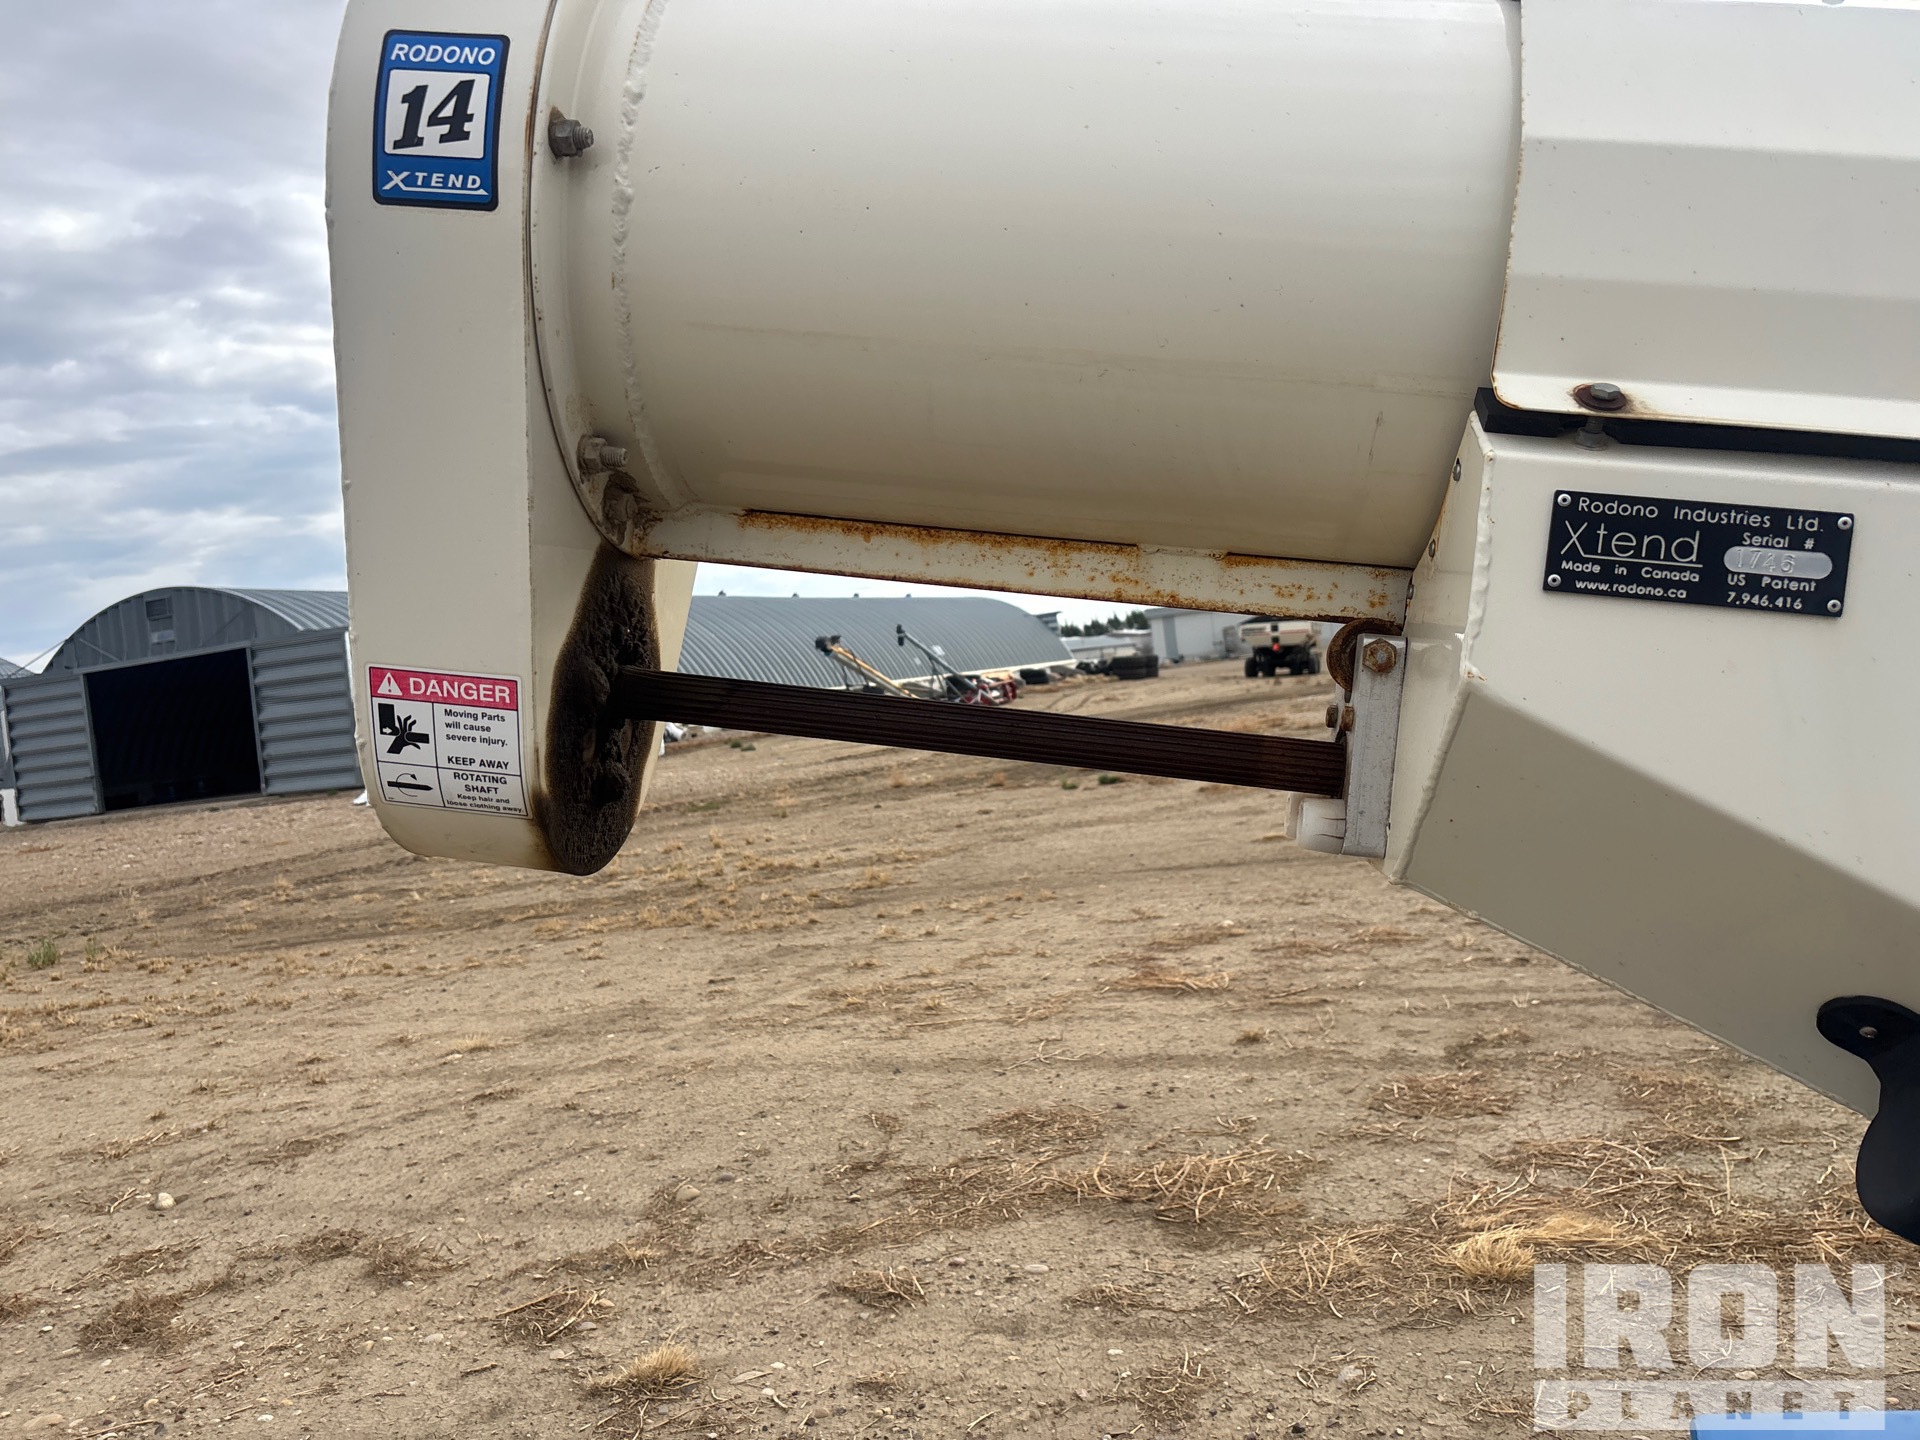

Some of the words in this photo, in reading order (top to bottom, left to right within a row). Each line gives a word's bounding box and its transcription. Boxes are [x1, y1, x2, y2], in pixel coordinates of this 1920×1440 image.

[390, 43, 496, 66] RODONO
[392, 79, 476, 150] 14
[382, 170, 482, 190] XTEND
[1578, 496, 1659, 519] Rodono
[1673, 506, 1771, 528] Industries
[1786, 515, 1824, 532] Ltd.
[1560, 520, 1701, 563] Xtend
[1742, 532, 1789, 548] Serial
[1803, 538, 1815, 550] #
[1561, 560, 1601, 573] Made
[1614, 564, 1628, 576] in
[1641, 566, 1700, 583] Canada
[1575, 579, 1688, 599] www.rodono.ca
[1727, 573, 1746, 586] US
[1761, 575, 1817, 592] Patent
[409, 677, 511, 704] DANGER
[444, 708, 479, 721] Moving
[481, 712, 506, 722] Parts
[444, 721, 461, 730] will
[463, 724, 492, 733] cause
[445, 733, 477, 743] severe
[479, 735, 508, 747] injury.
[447, 755, 476, 767] KEEP
[478, 757, 510, 770] AWAY
[453, 771, 508, 785] ROTATING
[456, 793, 478, 802] Keep
[478, 795, 494, 803] hair
[464, 784, 499, 795] SHAFT
[446, 799, 468, 807] loose
[469, 802, 501, 811] clothing
